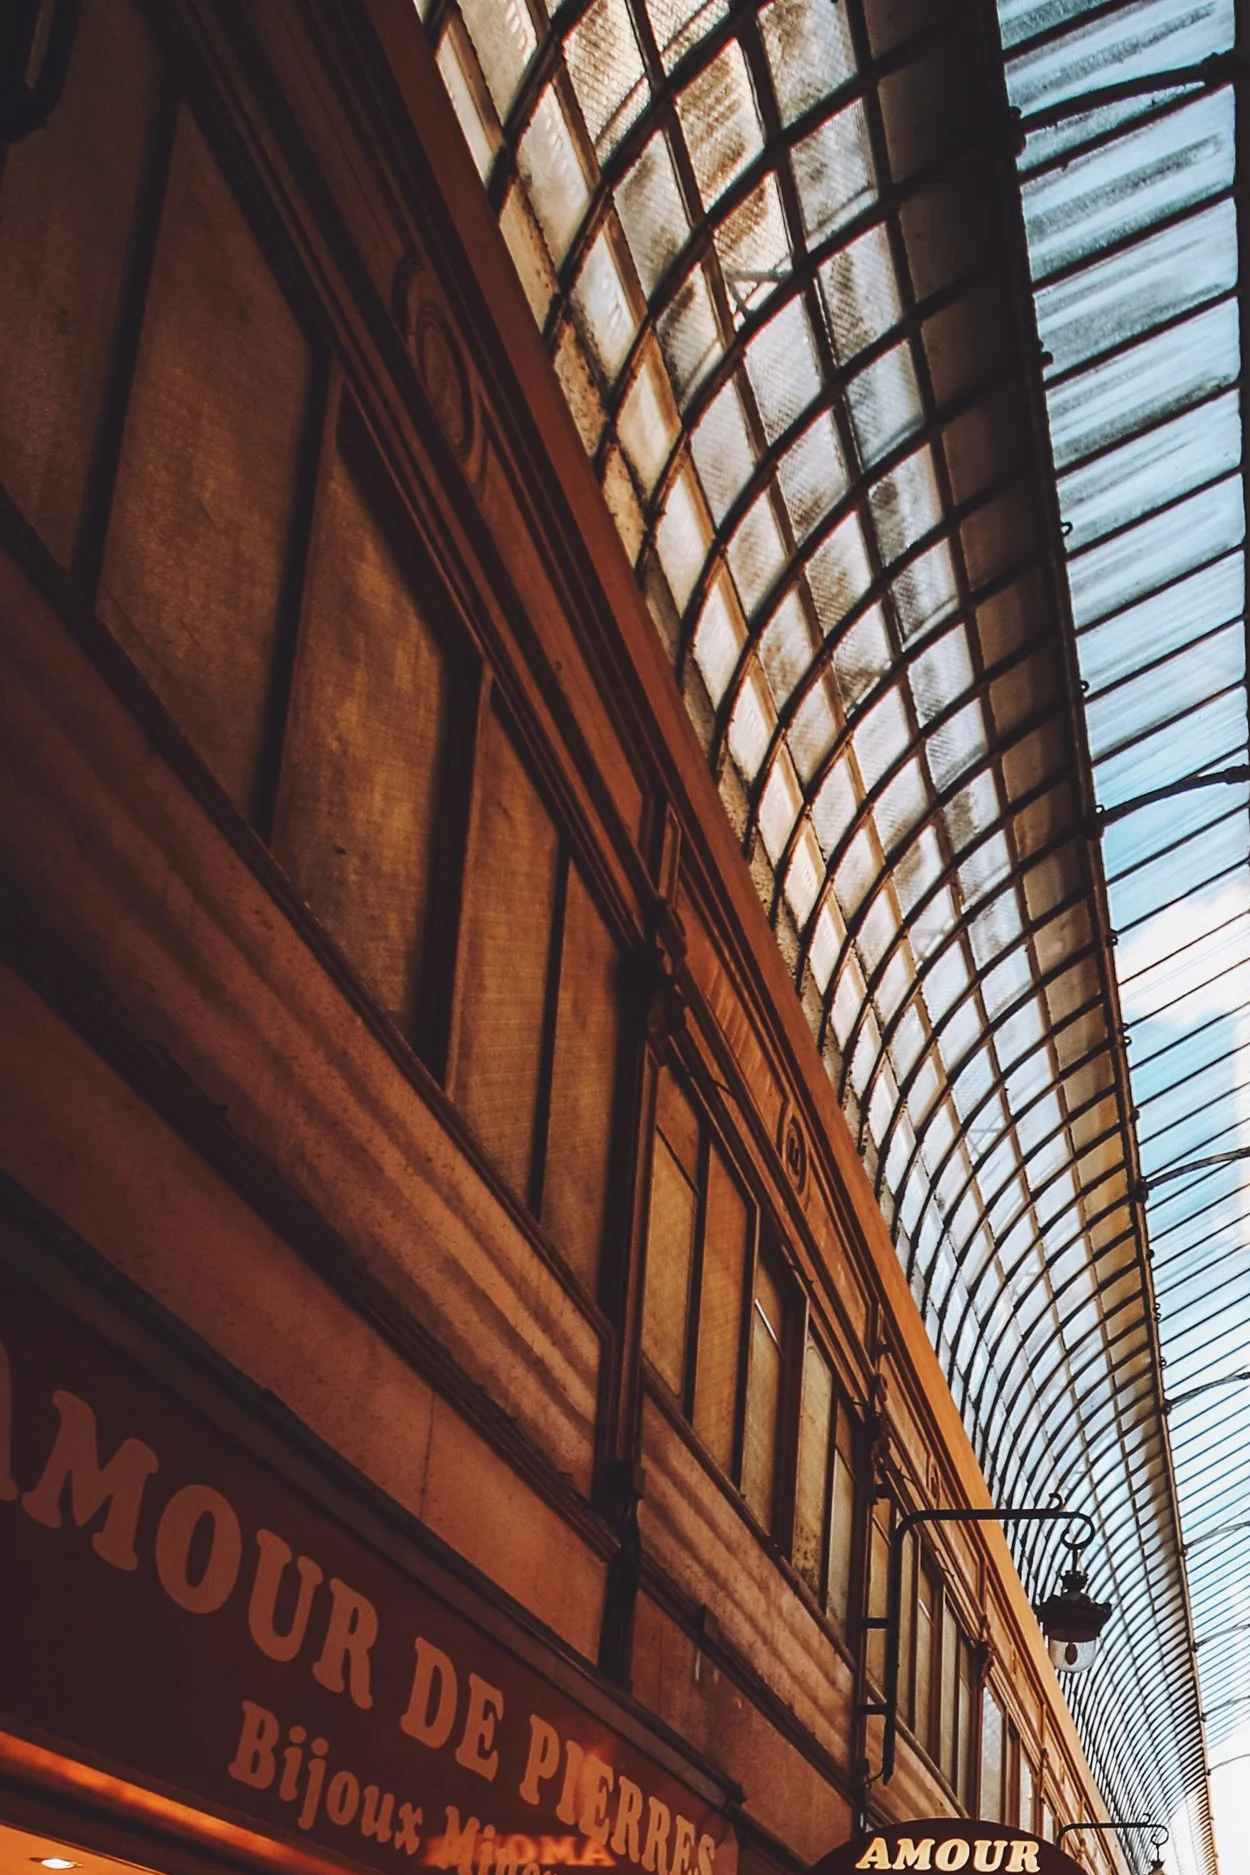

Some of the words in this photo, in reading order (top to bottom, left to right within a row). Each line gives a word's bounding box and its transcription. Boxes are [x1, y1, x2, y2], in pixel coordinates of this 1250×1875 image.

[0, 1340, 379, 1710] MOUR
[400, 1637, 504, 1781] DE
[229, 1701, 423, 1856] Bijoux
[855, 1836, 1041, 1874] AMOUR
